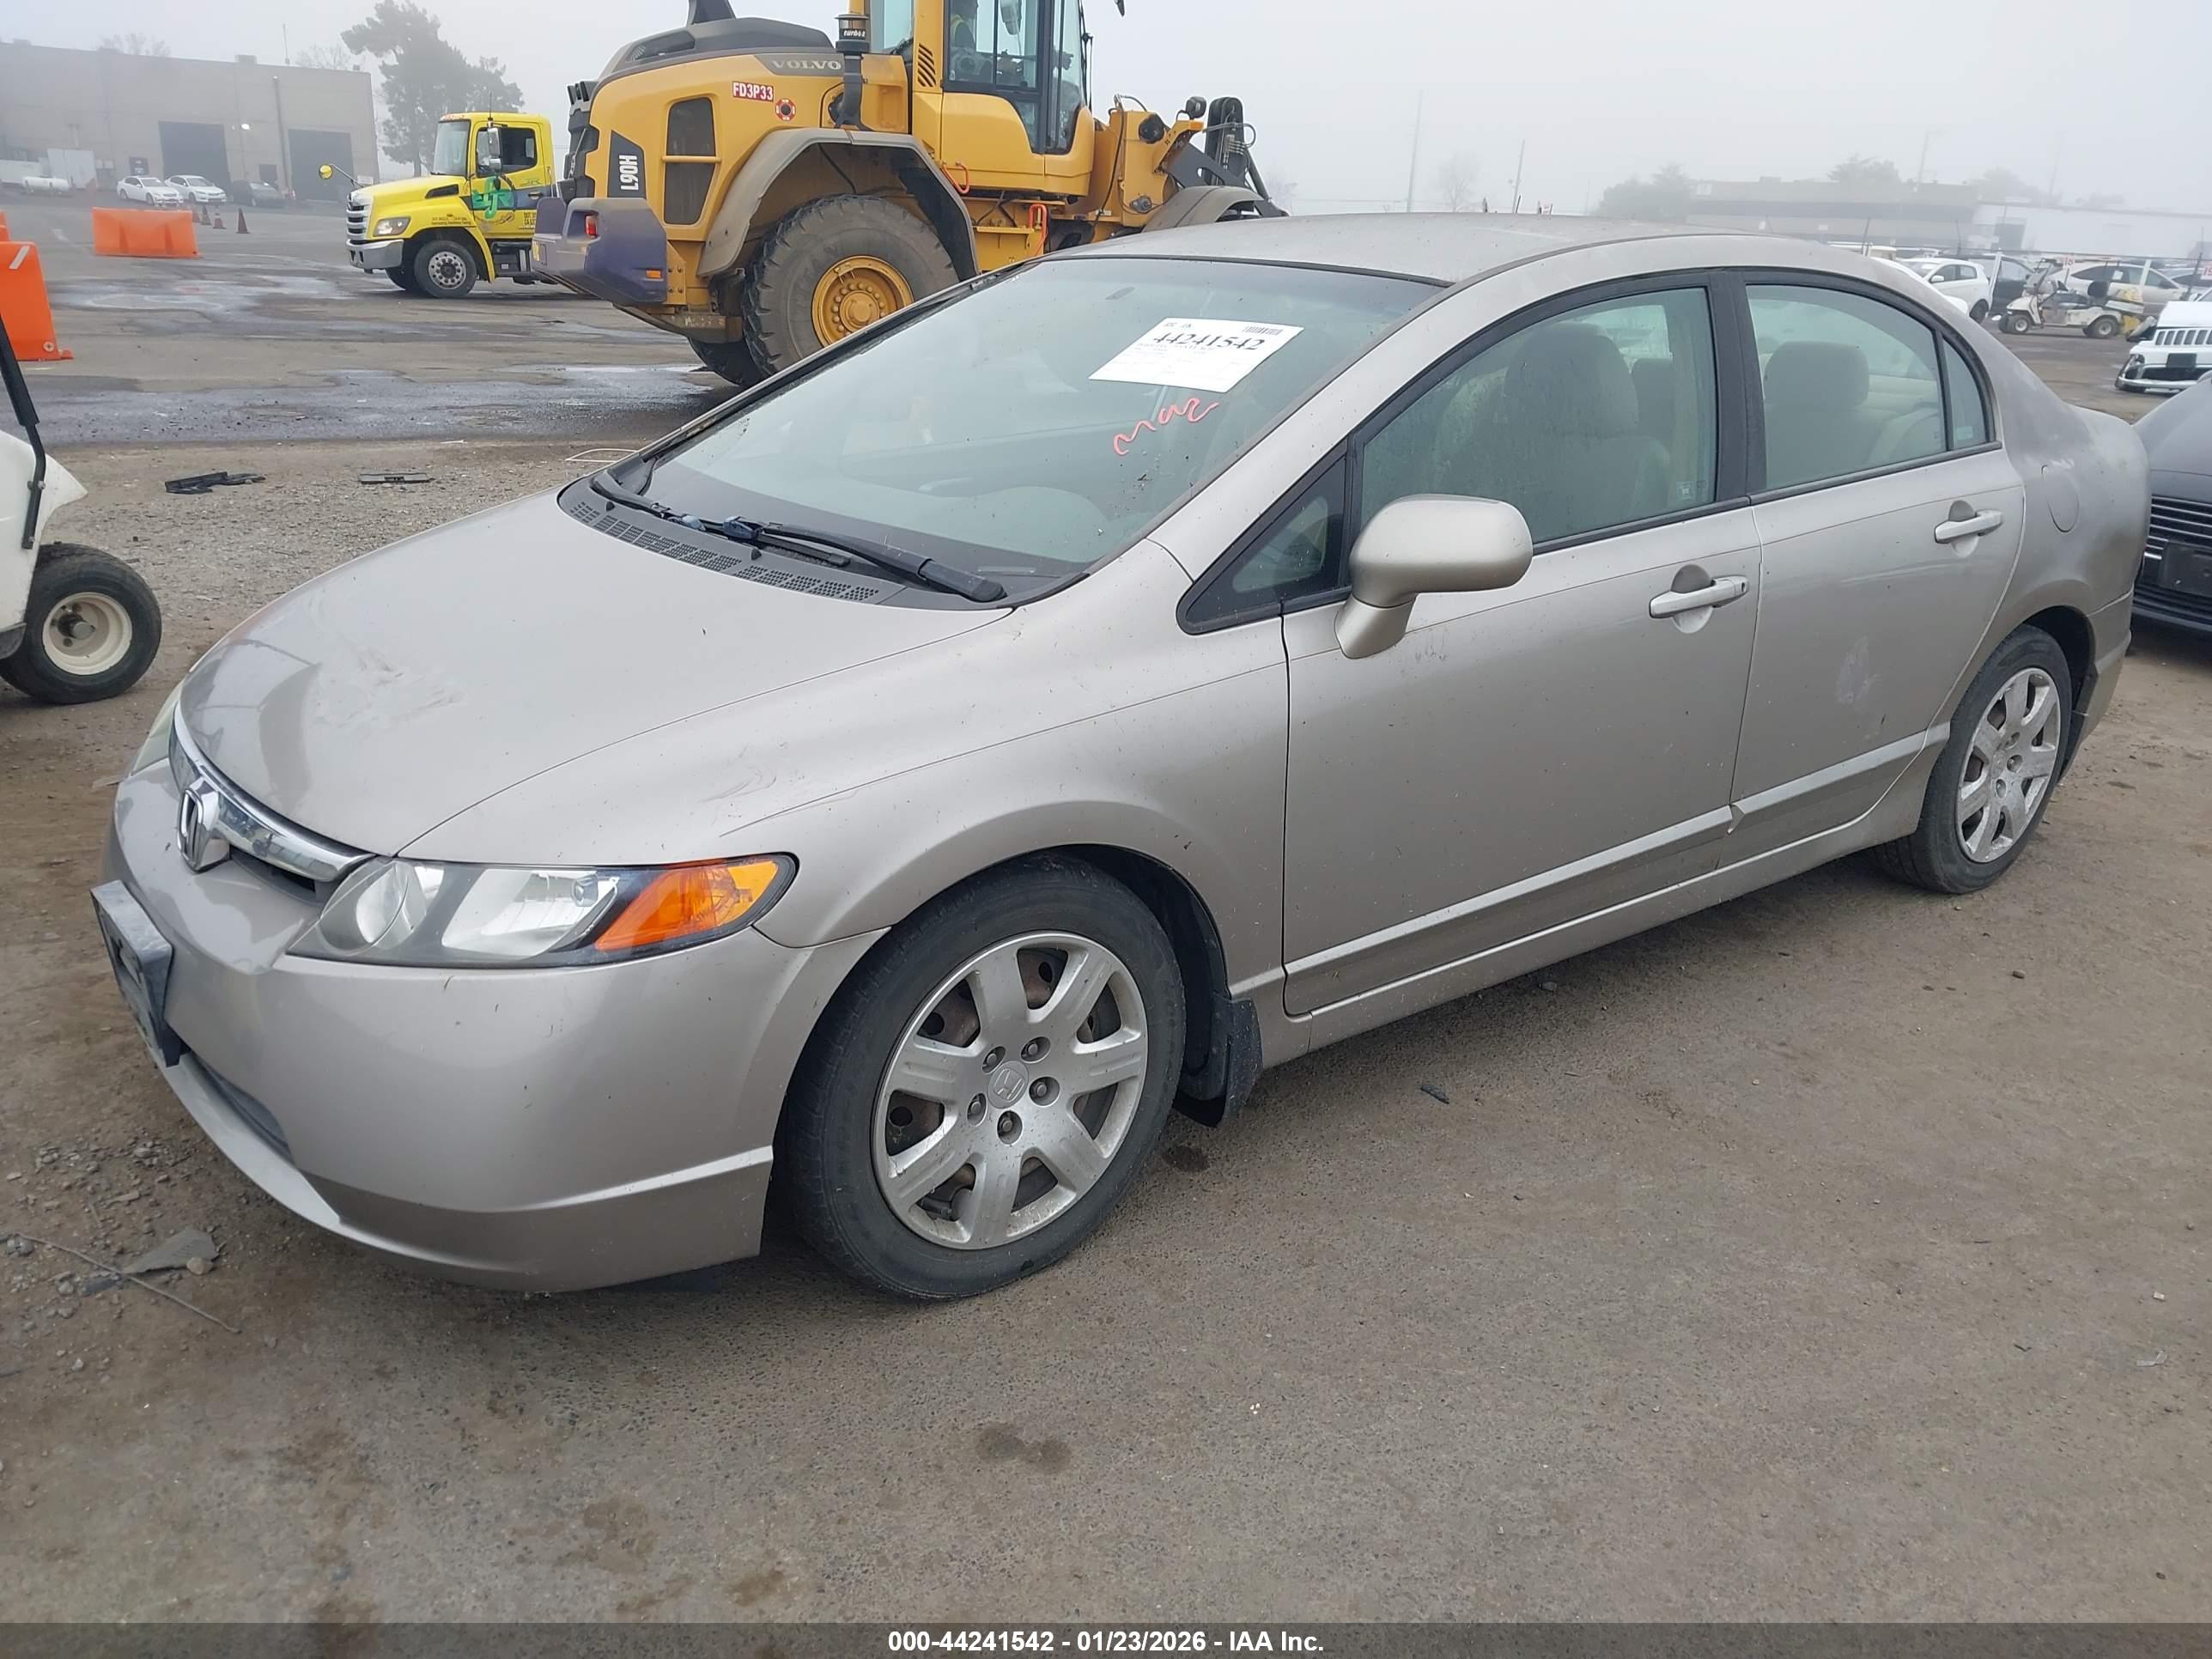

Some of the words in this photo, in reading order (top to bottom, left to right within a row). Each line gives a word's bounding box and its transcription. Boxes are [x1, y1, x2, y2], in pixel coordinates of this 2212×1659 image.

[771, 60, 842, 70] VOLVO
[732, 82, 774, 100] FD3P33
[619, 155, 639, 191] L90H
[1153, 332, 1266, 350] 44241542
